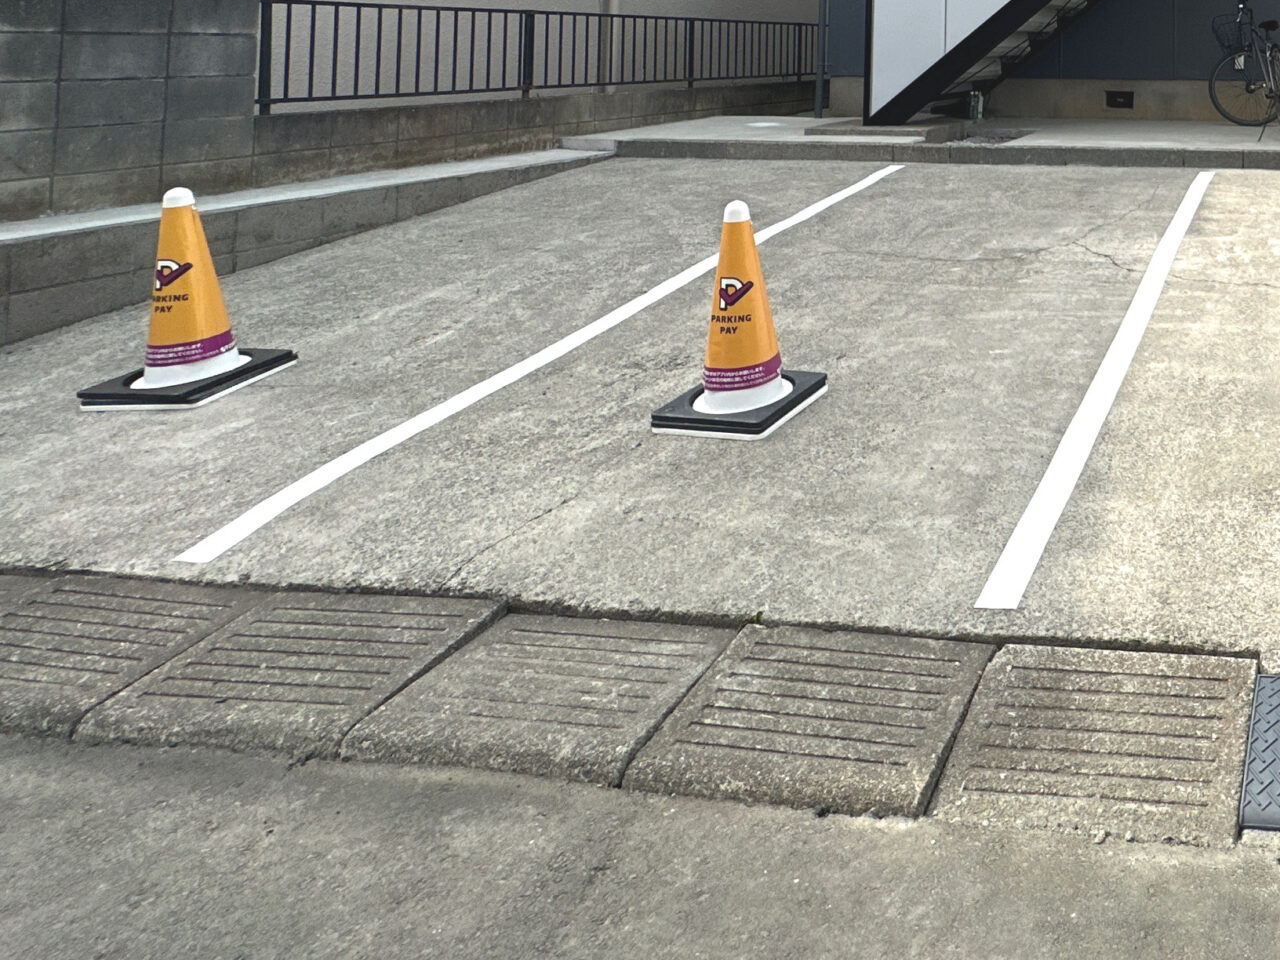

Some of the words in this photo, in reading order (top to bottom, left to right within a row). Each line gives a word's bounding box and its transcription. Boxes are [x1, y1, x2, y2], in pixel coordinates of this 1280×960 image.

[155, 305, 173, 313] PAY
[711, 314, 752, 323] PARKING
[720, 326, 738, 334] PAY
